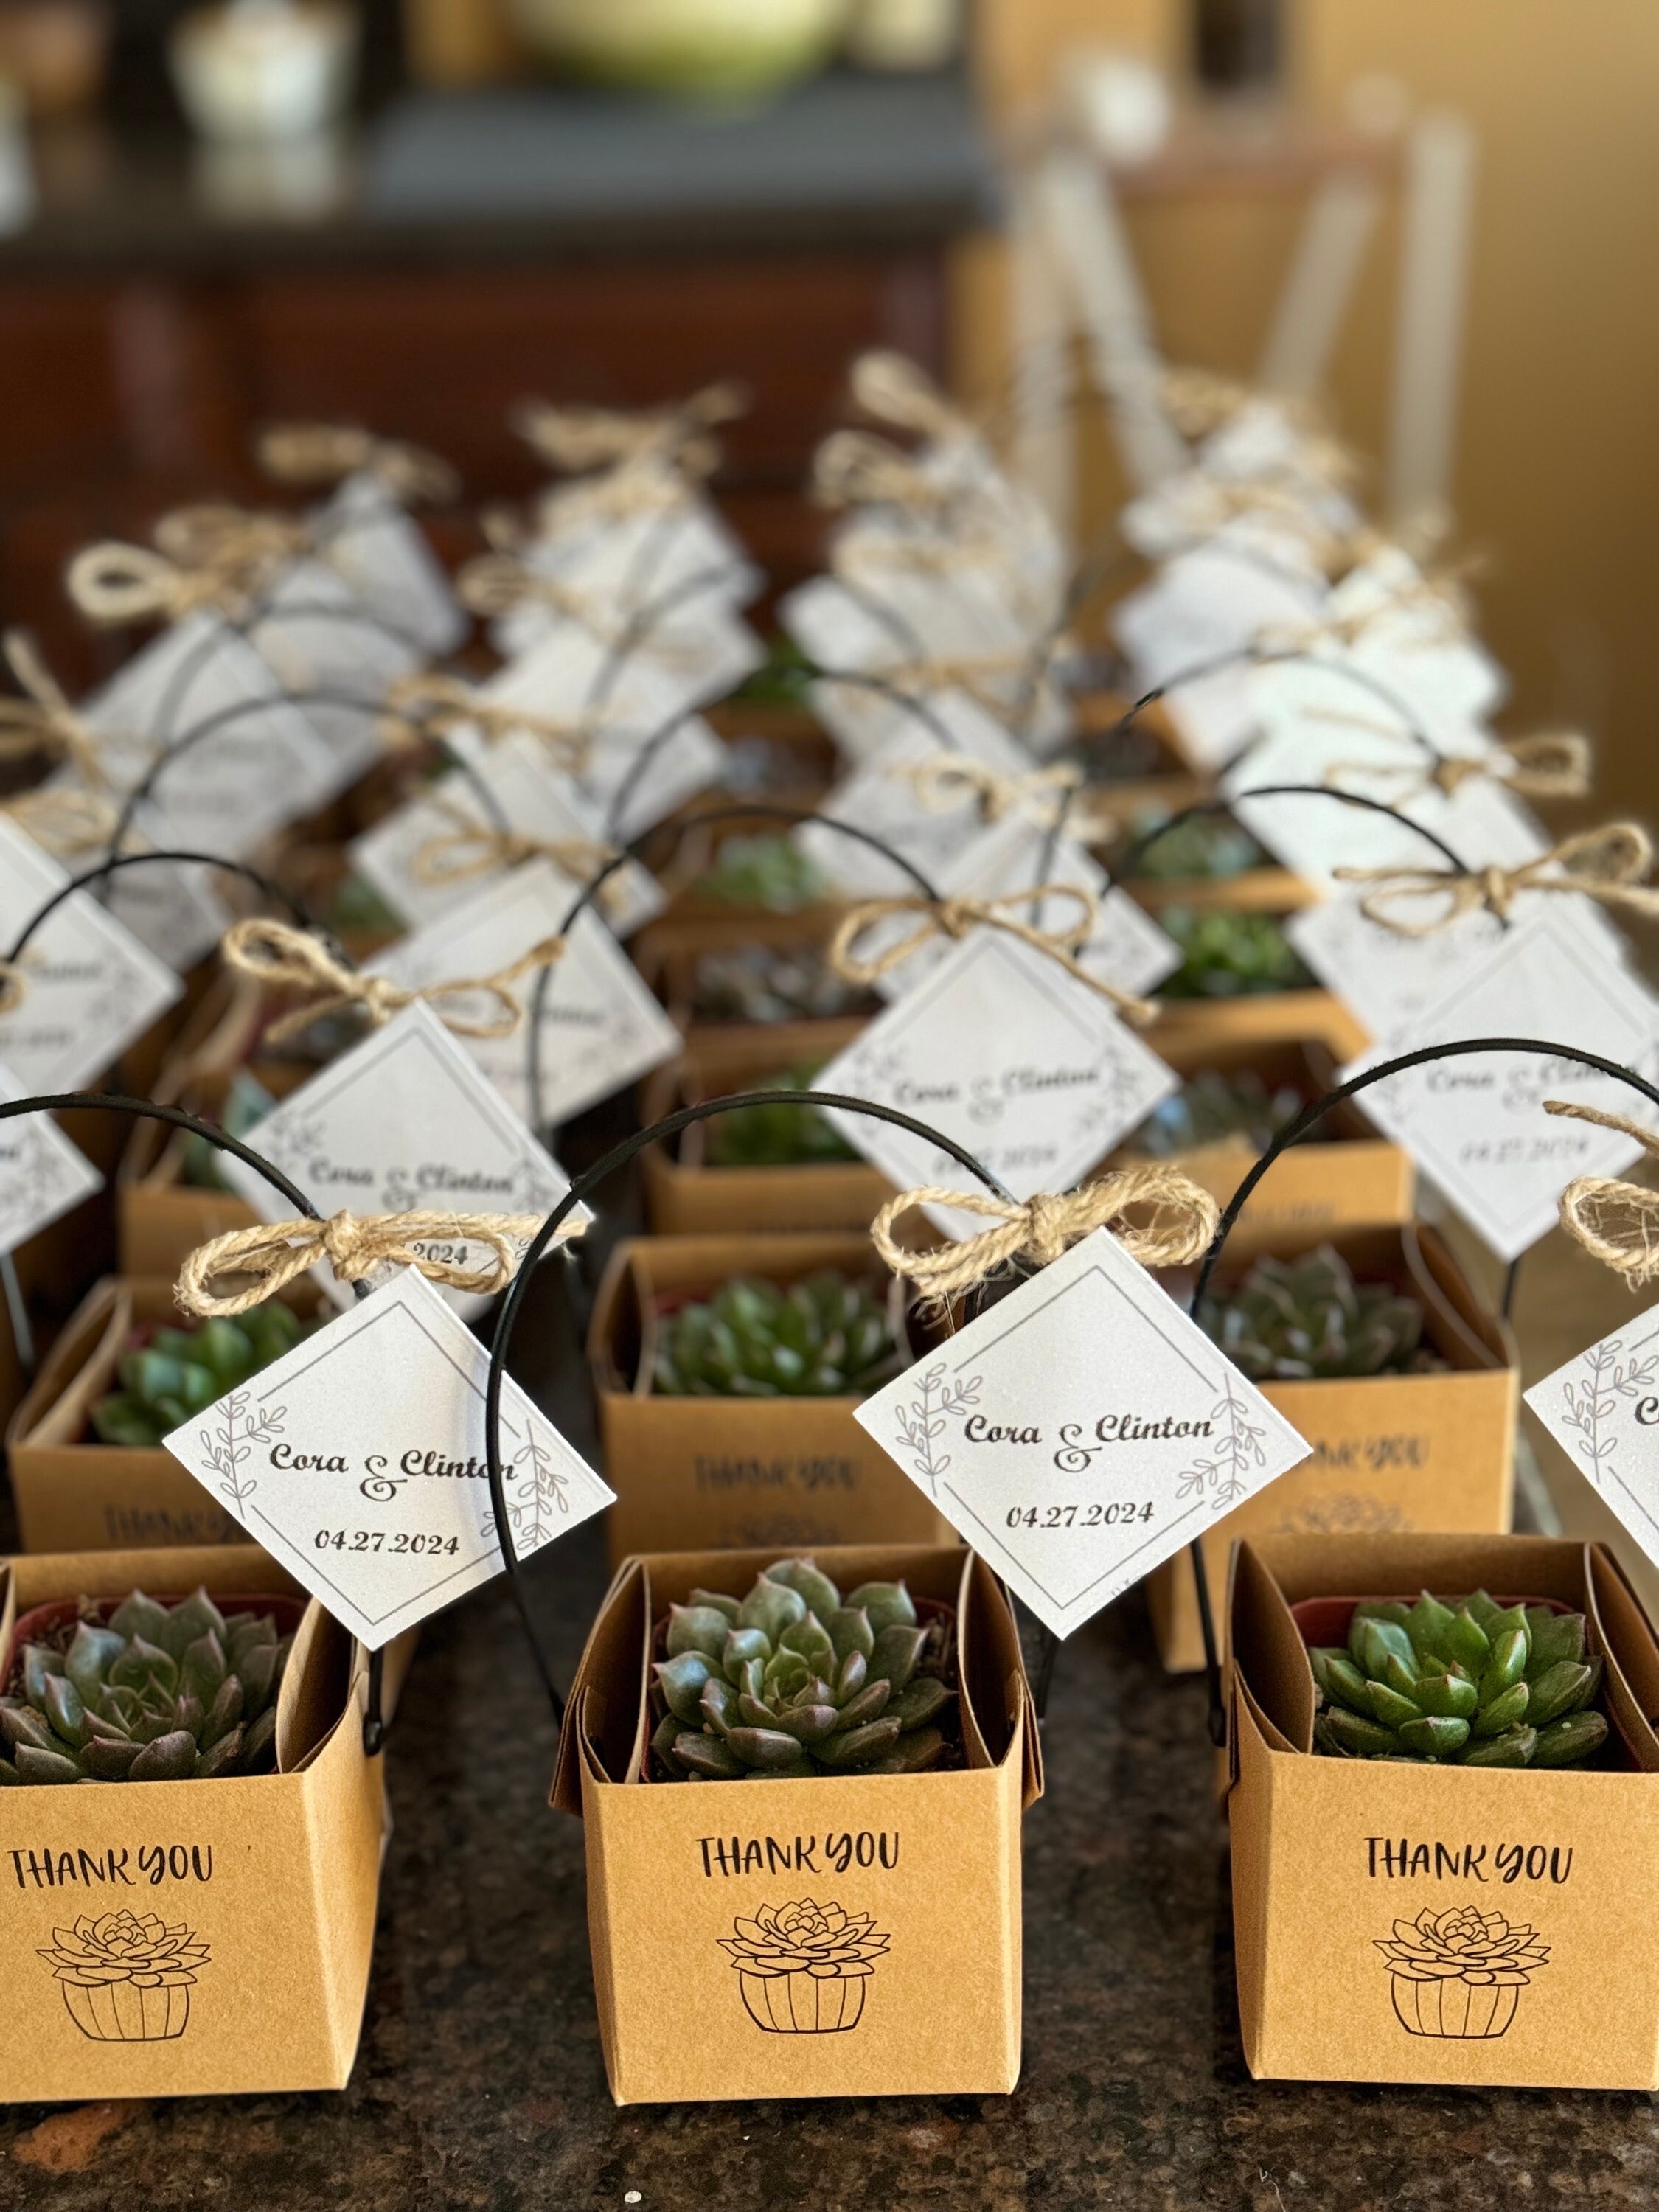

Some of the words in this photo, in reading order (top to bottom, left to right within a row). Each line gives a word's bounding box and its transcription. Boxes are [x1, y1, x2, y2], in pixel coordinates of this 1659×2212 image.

[964, 1414, 1043, 1445] Cora
[1053, 1423, 1103, 1473] &
[1095, 1413, 1215, 1443] Clinton
[270, 1443, 349, 1474] Cora
[359, 1454, 408, 1502] &
[1005, 1500, 1155, 1528] 04.27.2024
[313, 1528, 461, 1556] 04.27.2024
[7, 1848, 136, 1889] THANK
[138, 1844, 213, 1886] YOU
[695, 1835, 823, 1878] THANK
[824, 1831, 900, 1874] YOU
[1363, 1837, 1490, 1883] THANK
[1495, 1843, 1573, 1885] YOU
